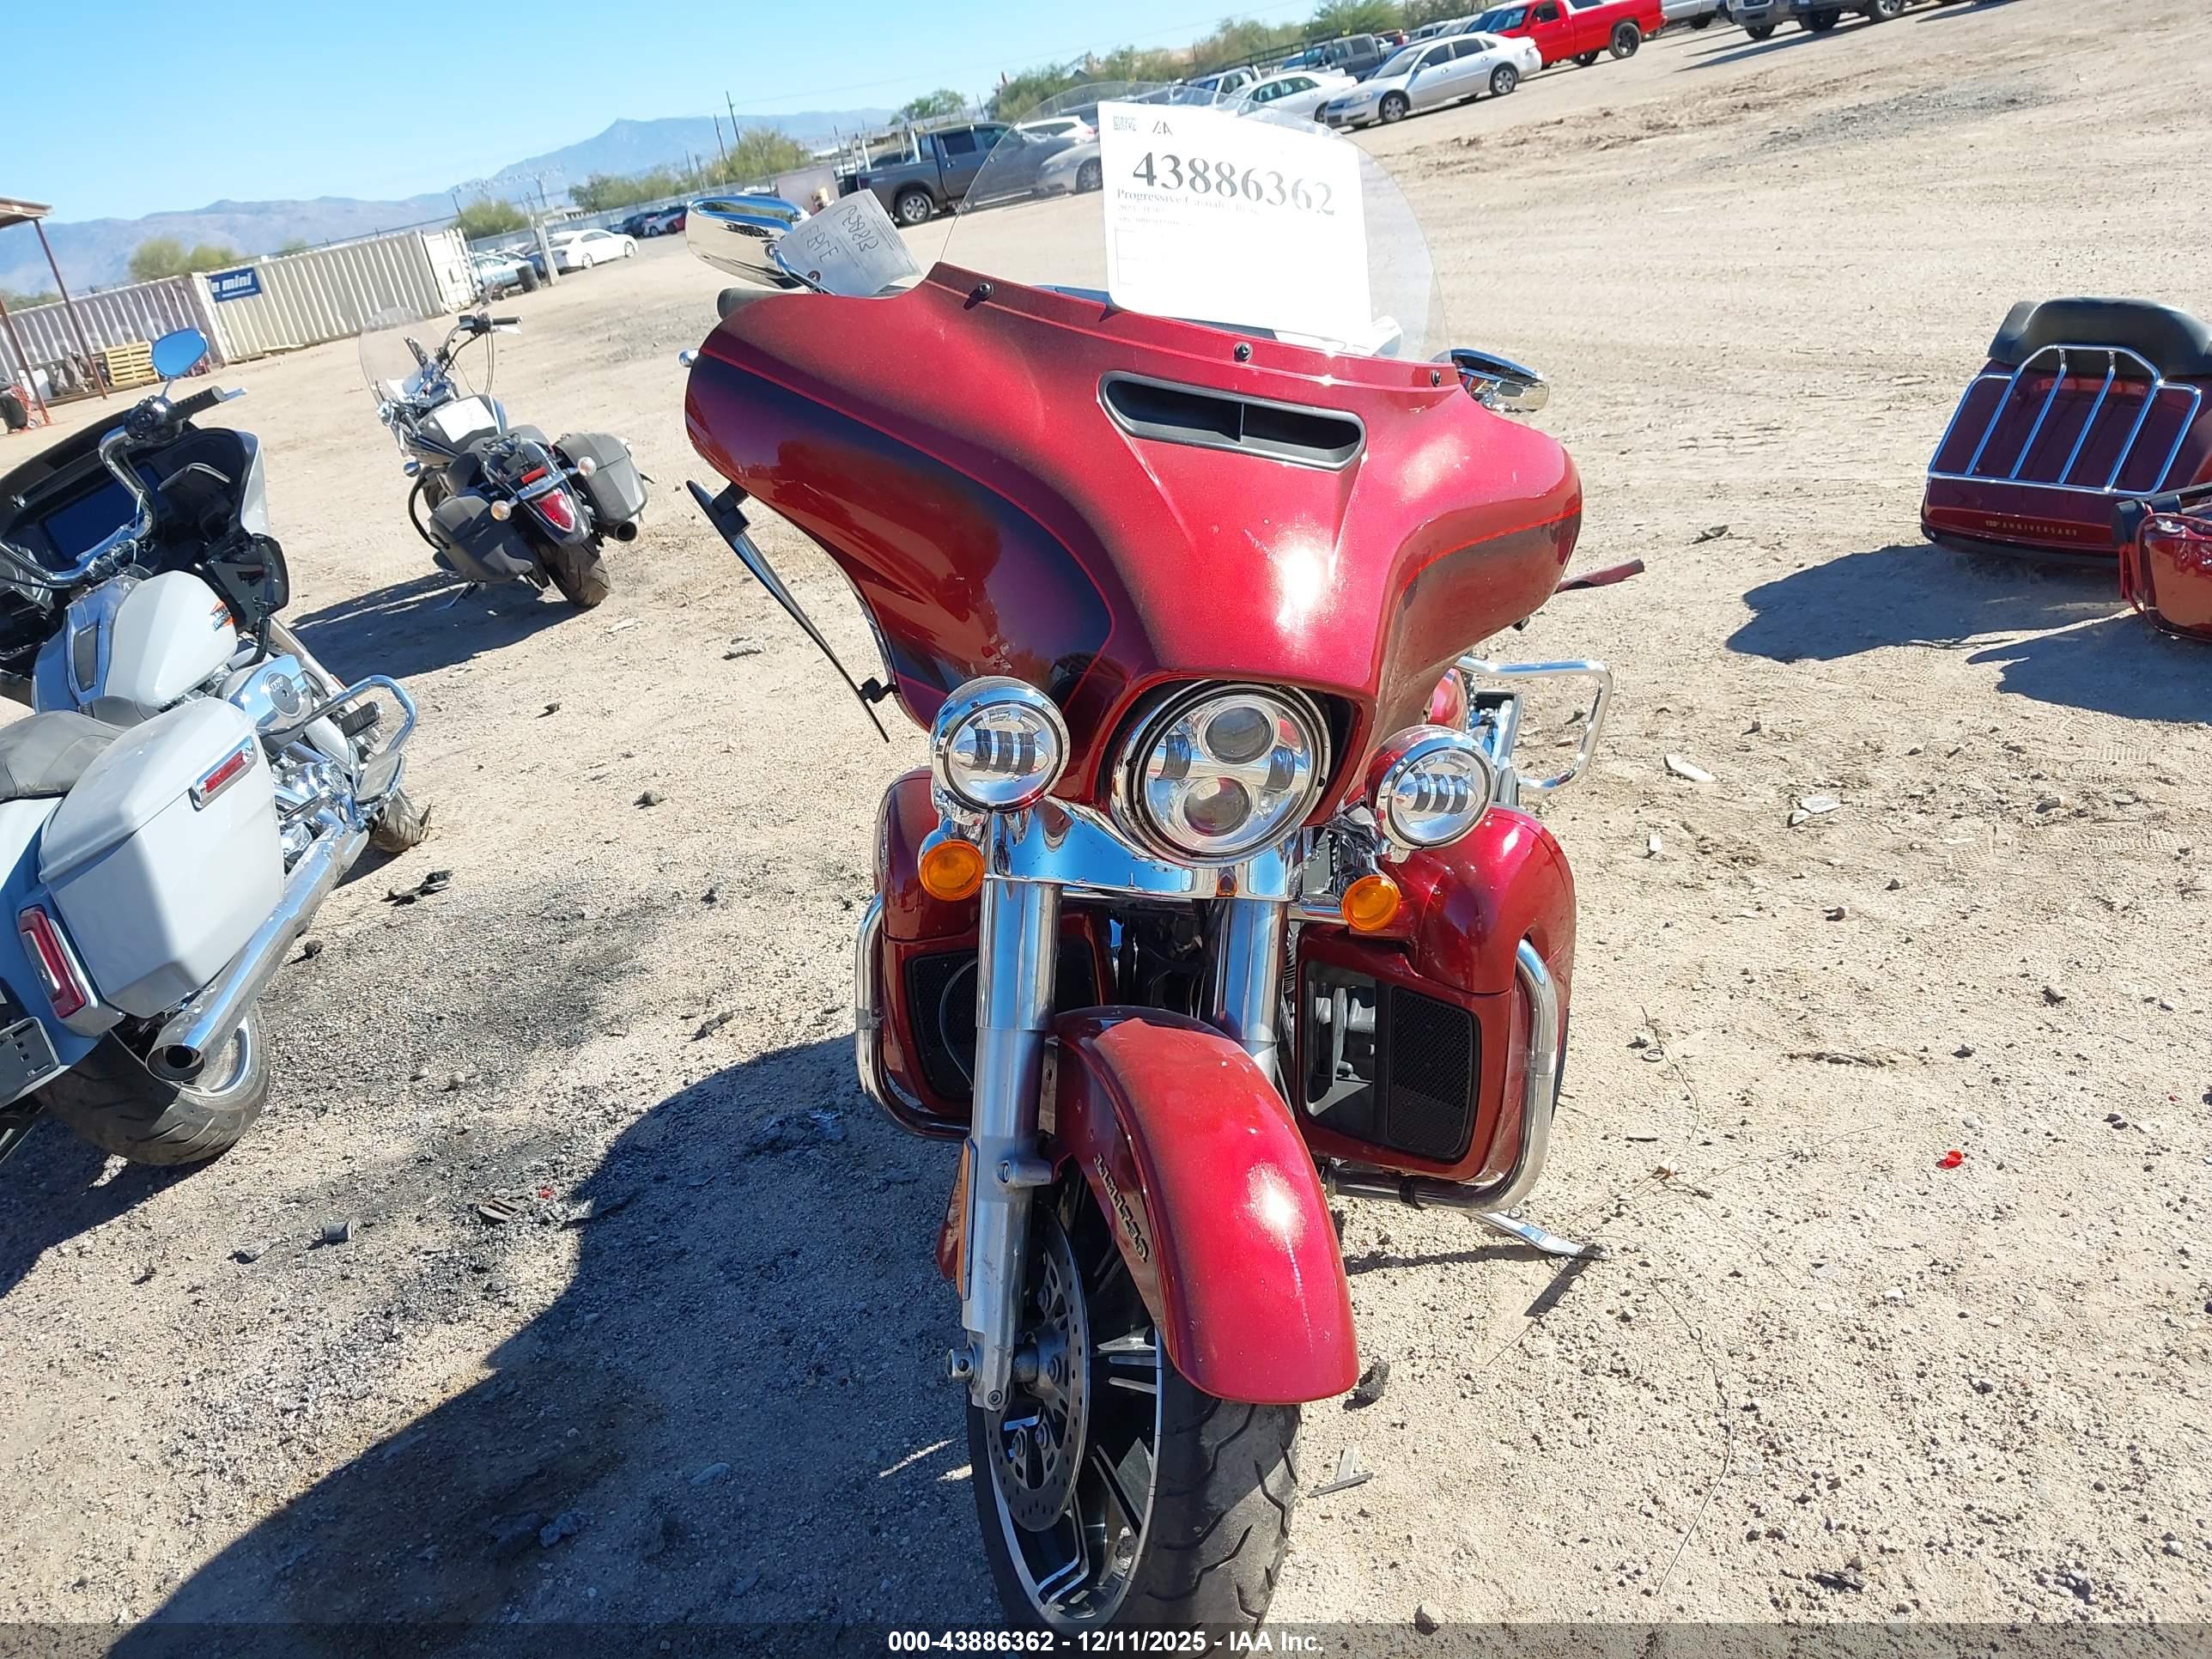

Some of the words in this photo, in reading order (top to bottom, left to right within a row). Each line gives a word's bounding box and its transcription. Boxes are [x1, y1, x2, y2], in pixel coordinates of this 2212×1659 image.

[1133, 151, 1335, 216] 43886362
[1117, 187, 1182, 204] Progressive
[222, 272, 252, 291] mini
[2002, 521, 2078, 536] ANNIVERSARY
[1093, 1153, 1150, 1263] LIMITED
